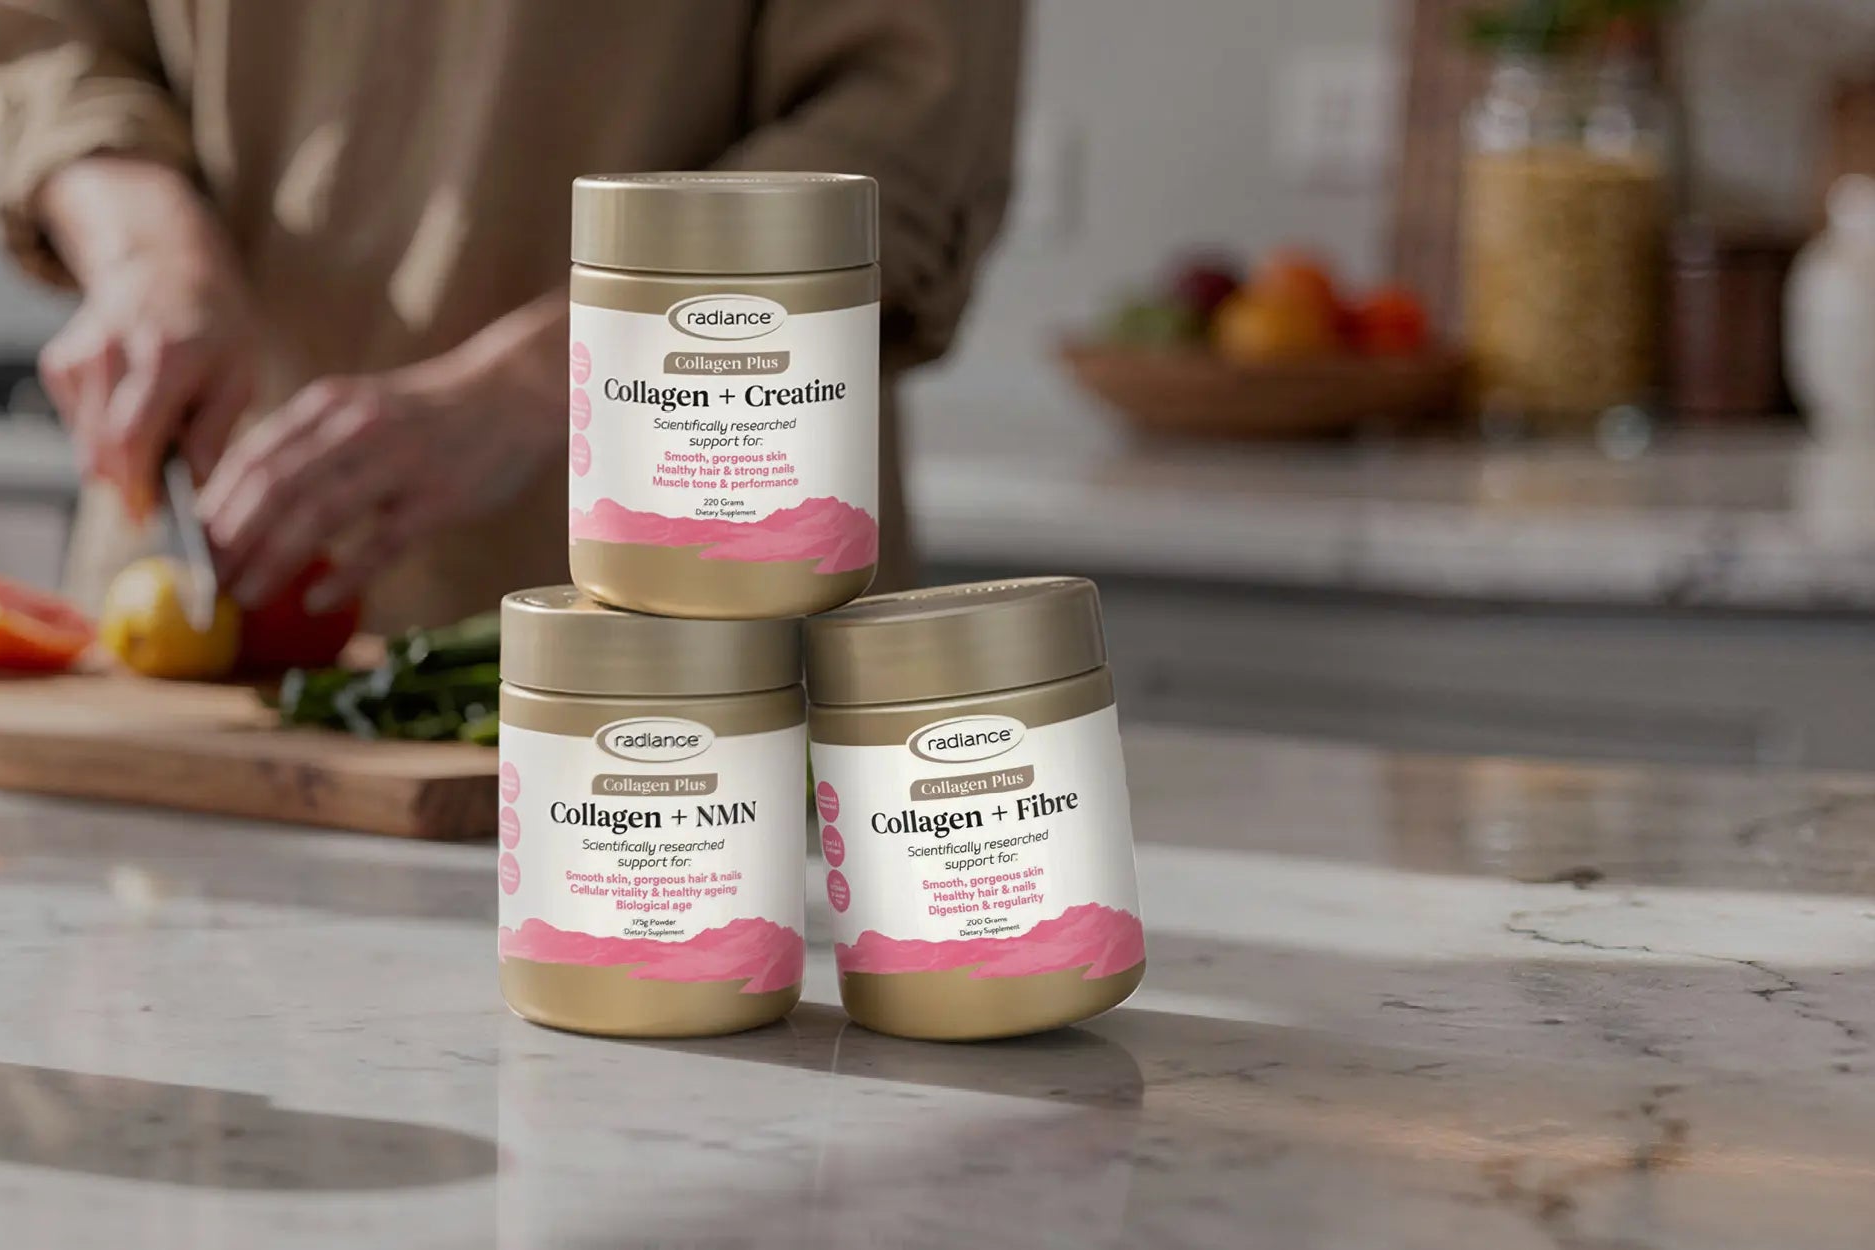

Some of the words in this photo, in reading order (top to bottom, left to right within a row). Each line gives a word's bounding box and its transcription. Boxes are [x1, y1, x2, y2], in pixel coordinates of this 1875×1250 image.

[675, 356, 742, 373] Collagen
[747, 356, 778, 369] Plus
[604, 378, 709, 412] Collagen
[719, 388, 736, 404] +
[744, 380, 846, 407] Creatine
[654, 418, 728, 434] Scientifically
[730, 418, 796, 431] researched
[689, 435, 740, 449] support
[665, 451, 709, 463] Smooth,
[712, 453, 763, 464] gorgeous
[766, 451, 787, 461] skin
[657, 464, 696, 477] Healthy
[699, 465, 720, 475] hair
[724, 466, 731, 475] &
[734, 466, 769, 477] strong
[771, 464, 794, 474] nails
[653, 476, 689, 488] Muscle
[692, 479, 717, 488] tone
[720, 479, 728, 488] &
[731, 477, 799, 491] performance
[704, 498, 718, 506] 220
[720, 498, 744, 506] Grams
[695, 509, 718, 517] Dietary
[720, 509, 756, 517] Supplement
[604, 778, 670, 795] Collagen
[674, 779, 707, 791] Plus
[921, 777, 987, 797] Collagen
[992, 772, 1024, 789] Plus
[550, 801, 661, 834] Collagen
[672, 809, 687, 824] +
[696, 801, 757, 828] NMN
[871, 808, 982, 839] Collagen
[992, 805, 1008, 821] +
[1017, 792, 1079, 822] Fibre
[582, 839, 656, 855] Scientifically
[658, 839, 725, 851] researched
[908, 841, 982, 859] Scientifically
[984, 830, 1049, 851] researched
[618, 856, 668, 870] support
[945, 856, 996, 872] support
[566, 871, 604, 883] Smooth
[607, 873, 631, 886] skin,
[634, 874, 686, 886] gorgeous
[688, 873, 708, 883] hair
[711, 873, 718, 882] &
[720, 871, 741, 881] nails
[922, 877, 967, 891] Smooth,
[970, 871, 1021, 888] gorgeous
[1023, 866, 1044, 879] skin
[570, 884, 609, 896] Cellular
[612, 886, 648, 899] vitality
[651, 887, 660, 897] &
[662, 887, 702, 900] healthy
[704, 885, 737, 896] ageing
[933, 888, 975, 903] Healthy
[978, 886, 999, 899] hair
[1002, 884, 1011, 895] &
[1013, 880, 1036, 893] nails
[616, 899, 670, 913] Biological
[672, 902, 692, 913] age
[928, 901, 979, 917] Digestion
[982, 900, 991, 910] &
[993, 892, 1044, 910] regularity
[966, 919, 982, 927] 200
[984, 917, 1007, 925] Grams
[624, 928, 647, 937] Dietary
[648, 928, 684, 937] Supplement
[960, 927, 982, 937] Dietary
[983, 924, 1020, 935] Supplement
